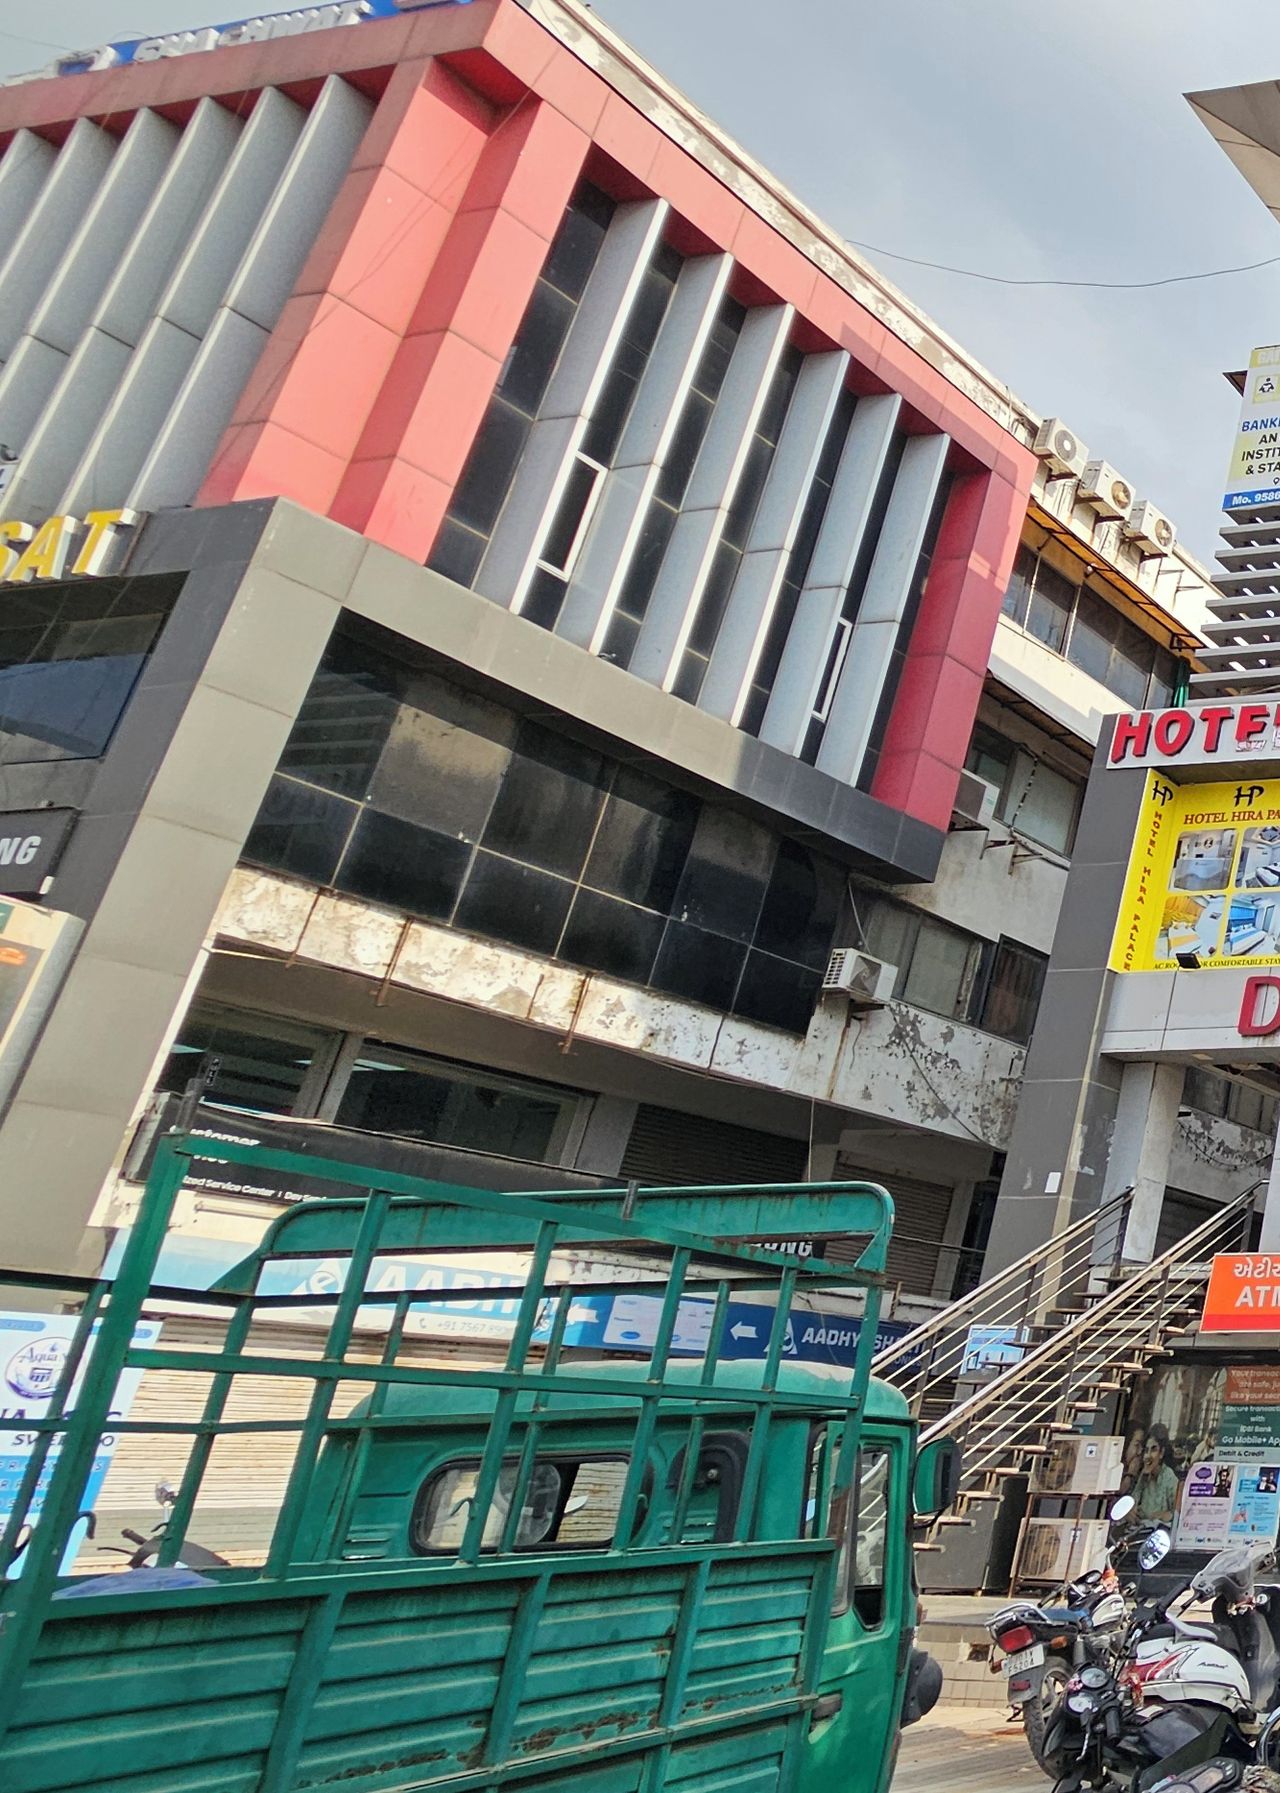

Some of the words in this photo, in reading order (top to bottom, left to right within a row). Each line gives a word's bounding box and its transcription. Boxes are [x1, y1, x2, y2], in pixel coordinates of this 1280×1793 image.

[1258, 434, 1277, 445] AN
[1245, 465, 1254, 475] &
[1232, 494, 1252, 505] Mo.
[1183, 812, 1228, 825] HOTEL
[1231, 809, 1263, 822] HIRA
[1210, 958, 1263, 968] COMFORTABLE
[1222, 1435, 1233, 1443] Go
